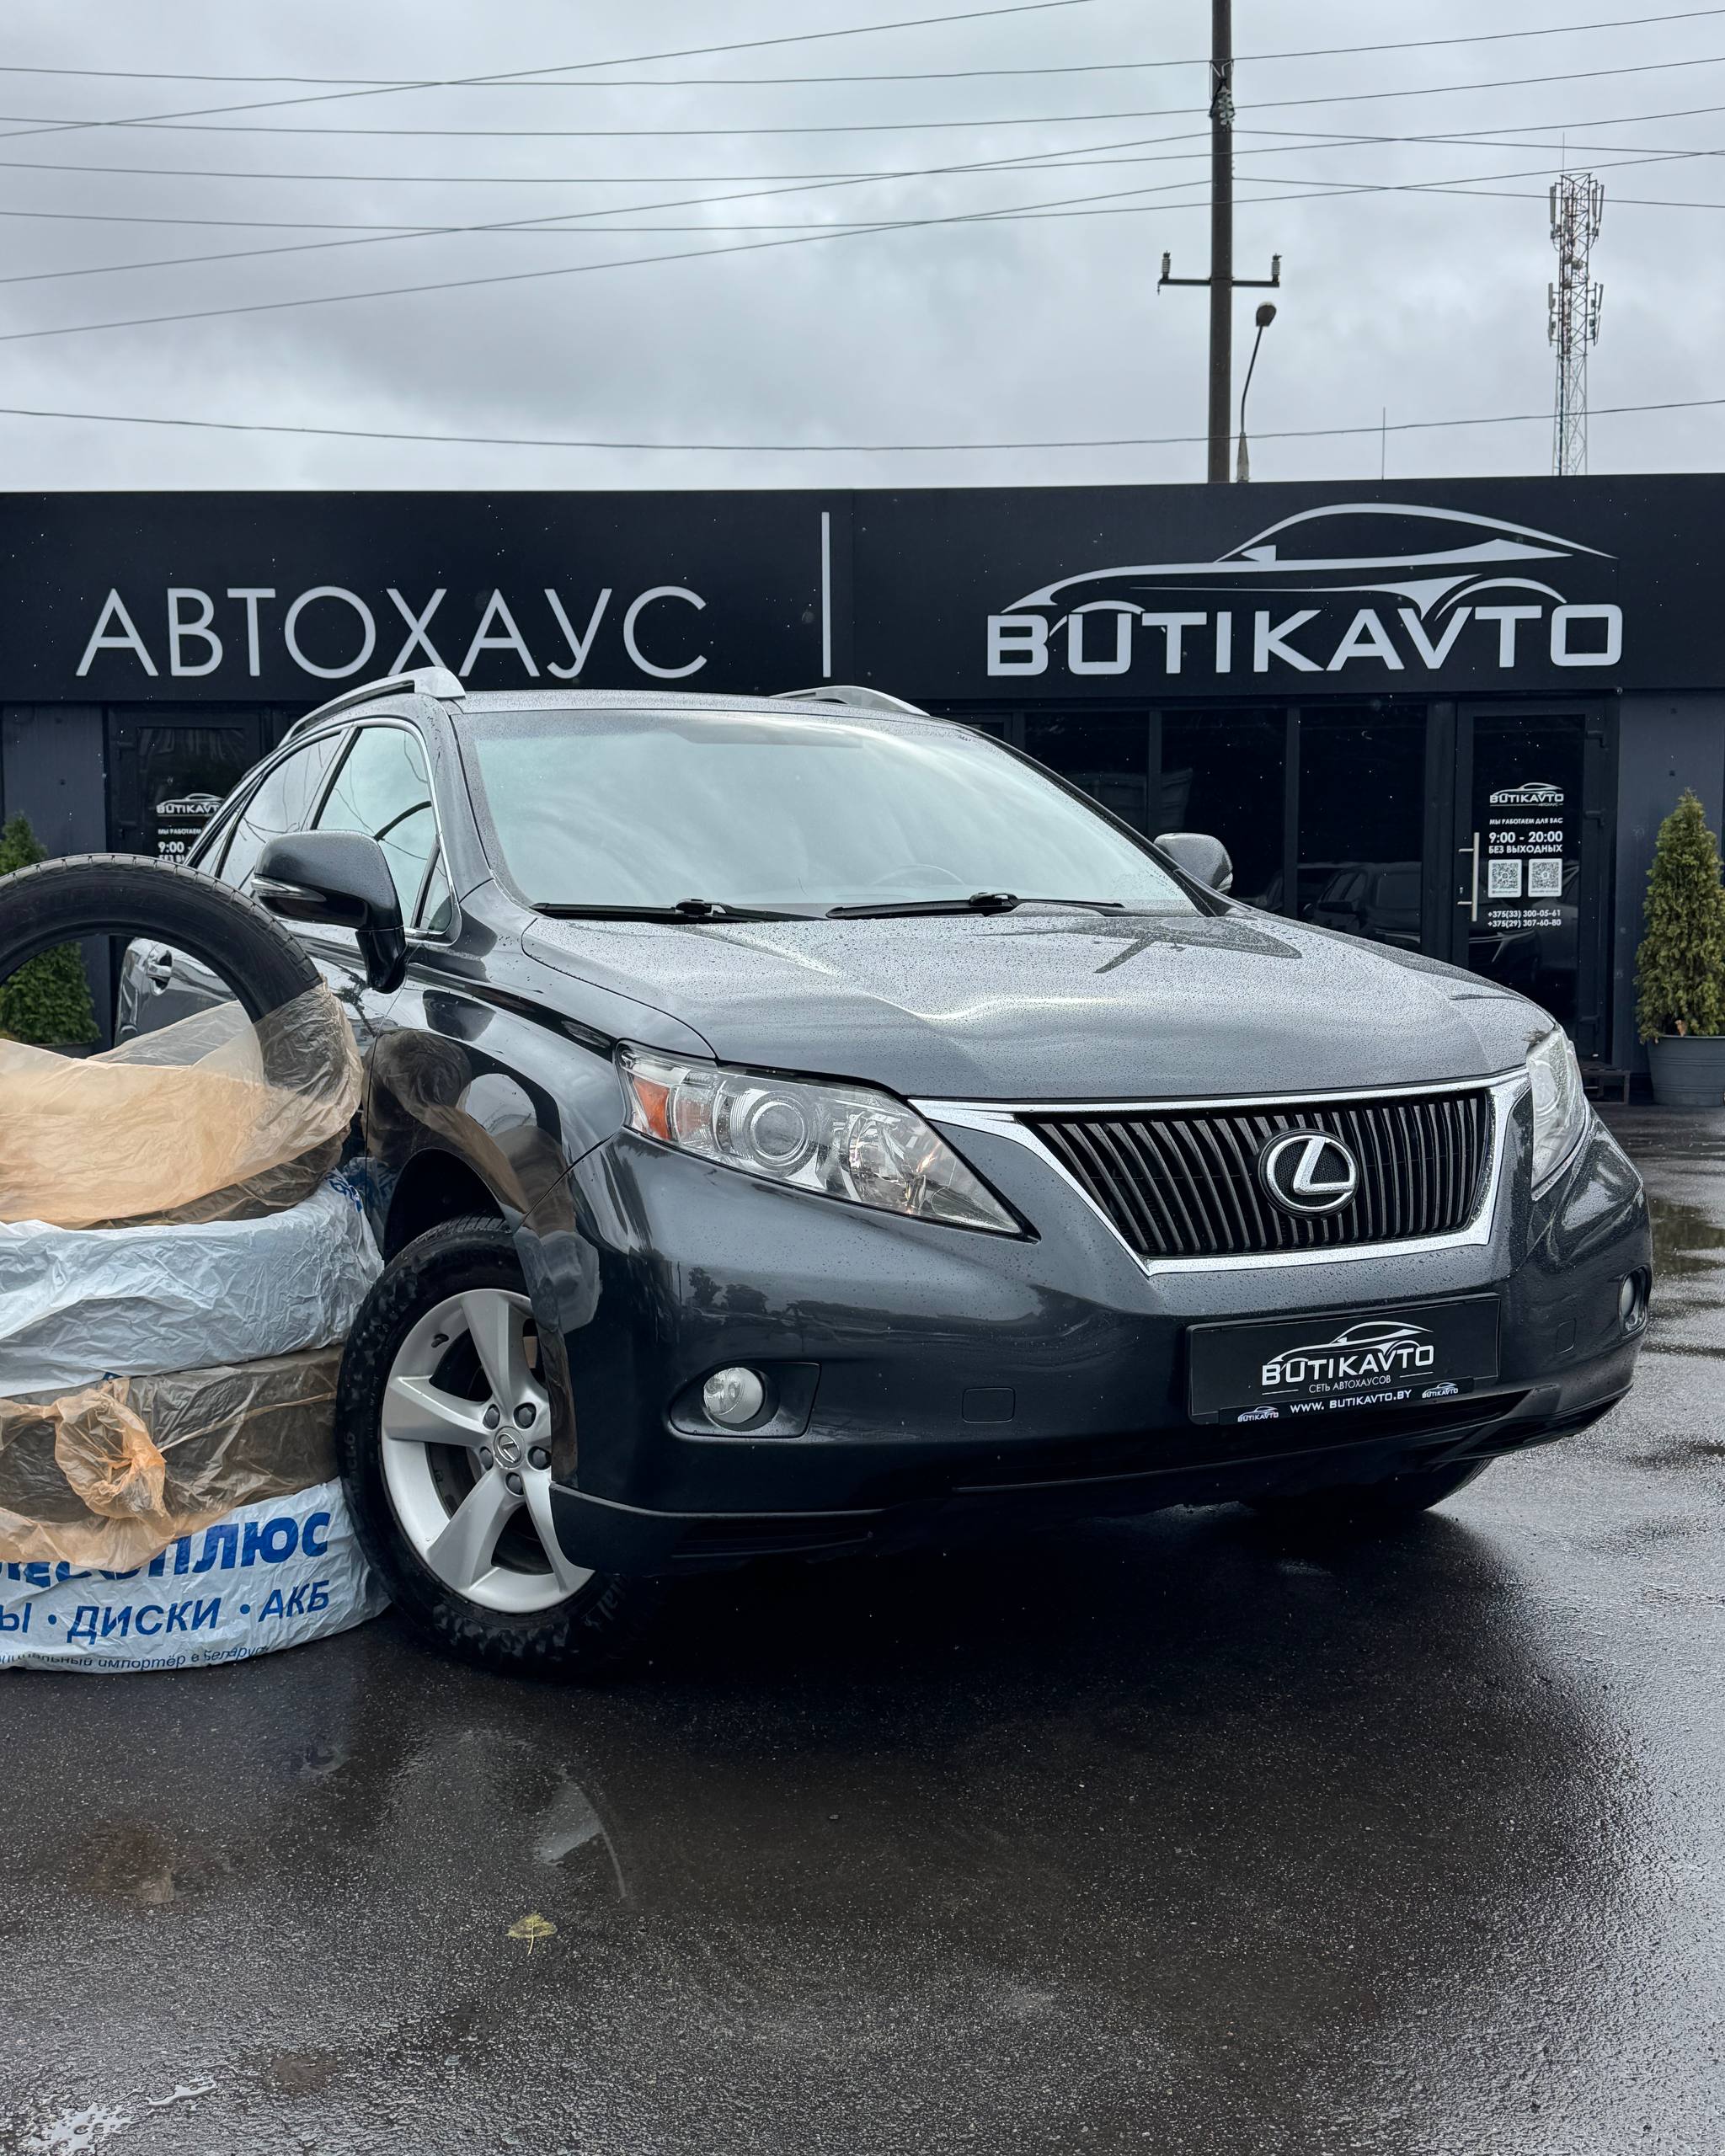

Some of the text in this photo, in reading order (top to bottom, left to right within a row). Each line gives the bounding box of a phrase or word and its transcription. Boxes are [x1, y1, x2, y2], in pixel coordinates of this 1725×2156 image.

[76, 585, 708, 680] АВТОХАУС
[986, 603, 1623, 676] BUTIKAVTO
[1489, 793, 1564, 803] BUTIKAVTO
[156, 804, 220, 814] BUTIKAVT
[1488, 831, 1516, 844] 9:00
[1528, 830, 1563, 843] 20:00
[158, 841, 184, 853] 9:00
[1488, 844, 1563, 855] БЕЗ ВЫХОДНЫХ
[1487, 910, 1521, 919] +375(33)
[1262, 1345, 1434, 1386] BUTIKAVTO
[1308, 1374, 1391, 1394] СЕТЬ АВТОХАУСОВ
[1329, 1390, 1413, 1410] BUTIKAVTO.BY
[67, 1580, 329, 1645] ДИСКИ АКБ
[98, 1655, 185, 1671] импортёр
